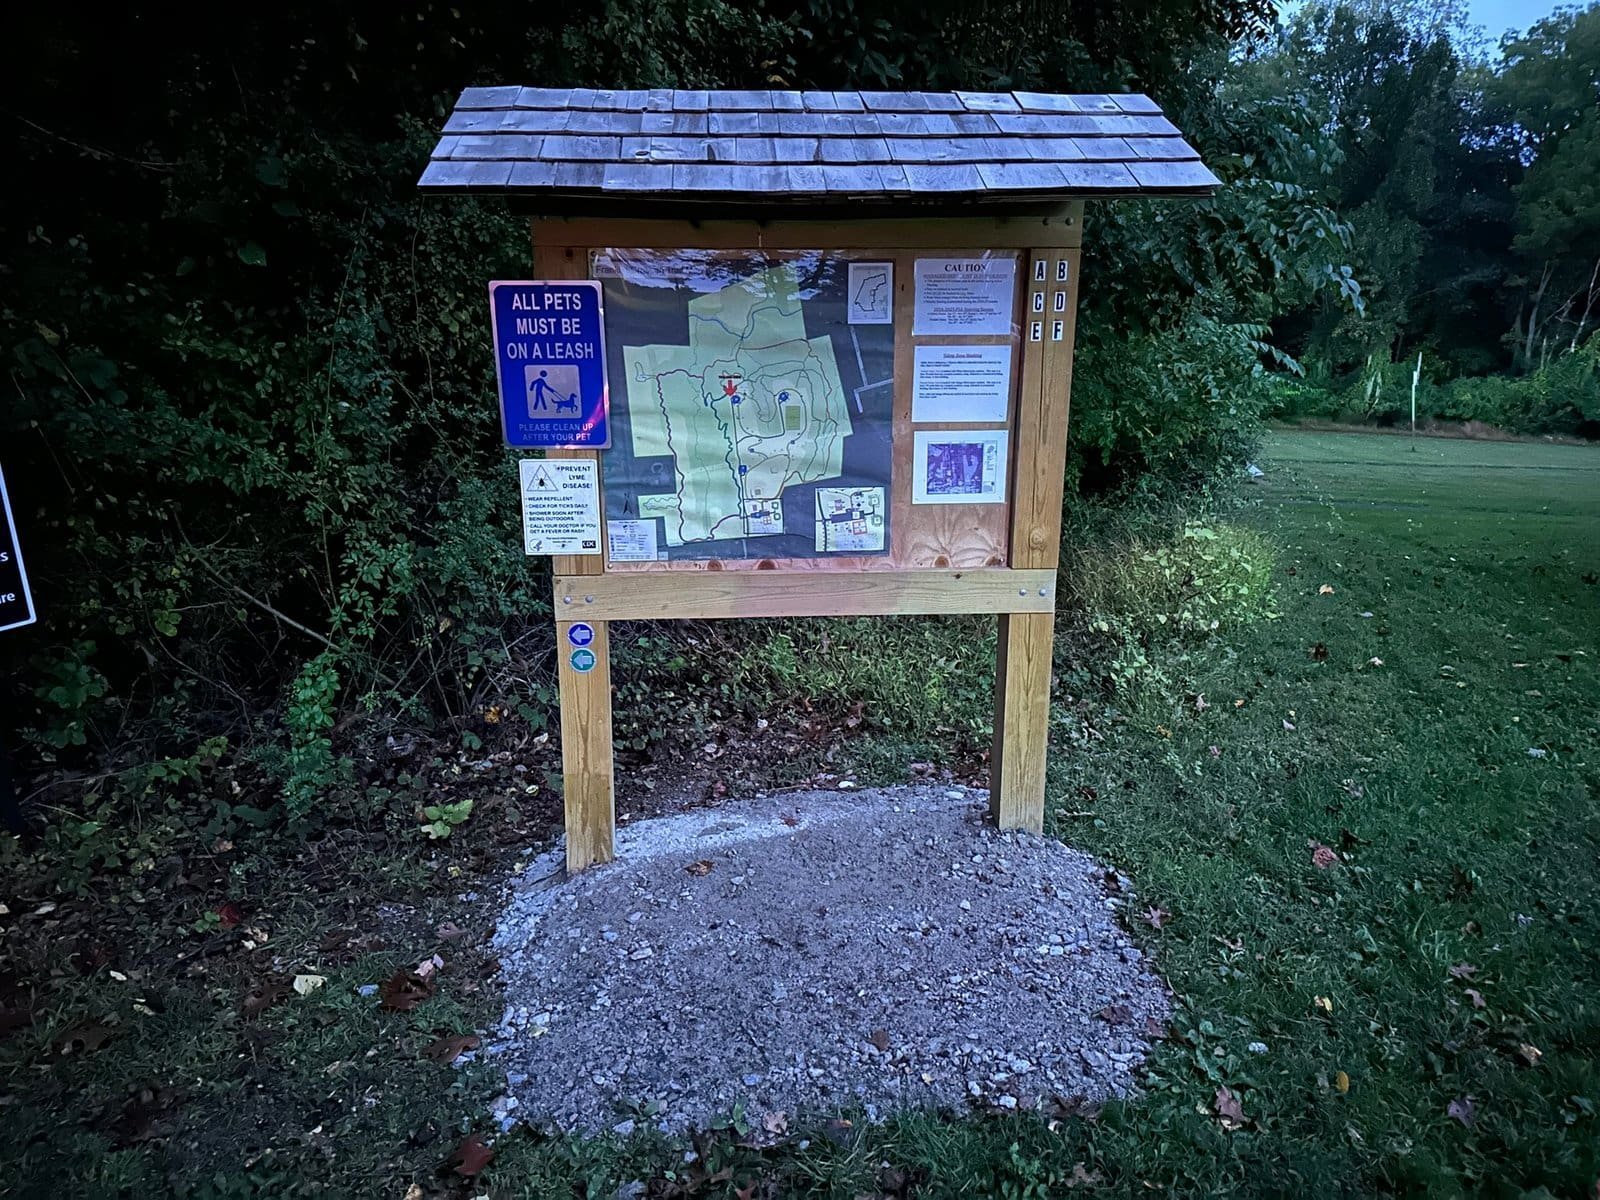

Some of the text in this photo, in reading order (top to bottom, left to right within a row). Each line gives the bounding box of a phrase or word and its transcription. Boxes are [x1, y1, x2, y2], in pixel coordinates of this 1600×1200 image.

[944, 264, 987, 272] CAUTION
[1036, 262, 1066, 280] A B
[512, 293, 582, 310] ALL PETS
[1035, 293, 1064, 311] C D
[516, 318, 582, 335] MUST BE
[1032, 322, 1061, 340] E F
[507, 342, 594, 359] ON A LEASH
[519, 423, 550, 431] PLEASE
[582, 423, 594, 431] UP
[522, 433, 592, 441] AFTER YOUR PET
